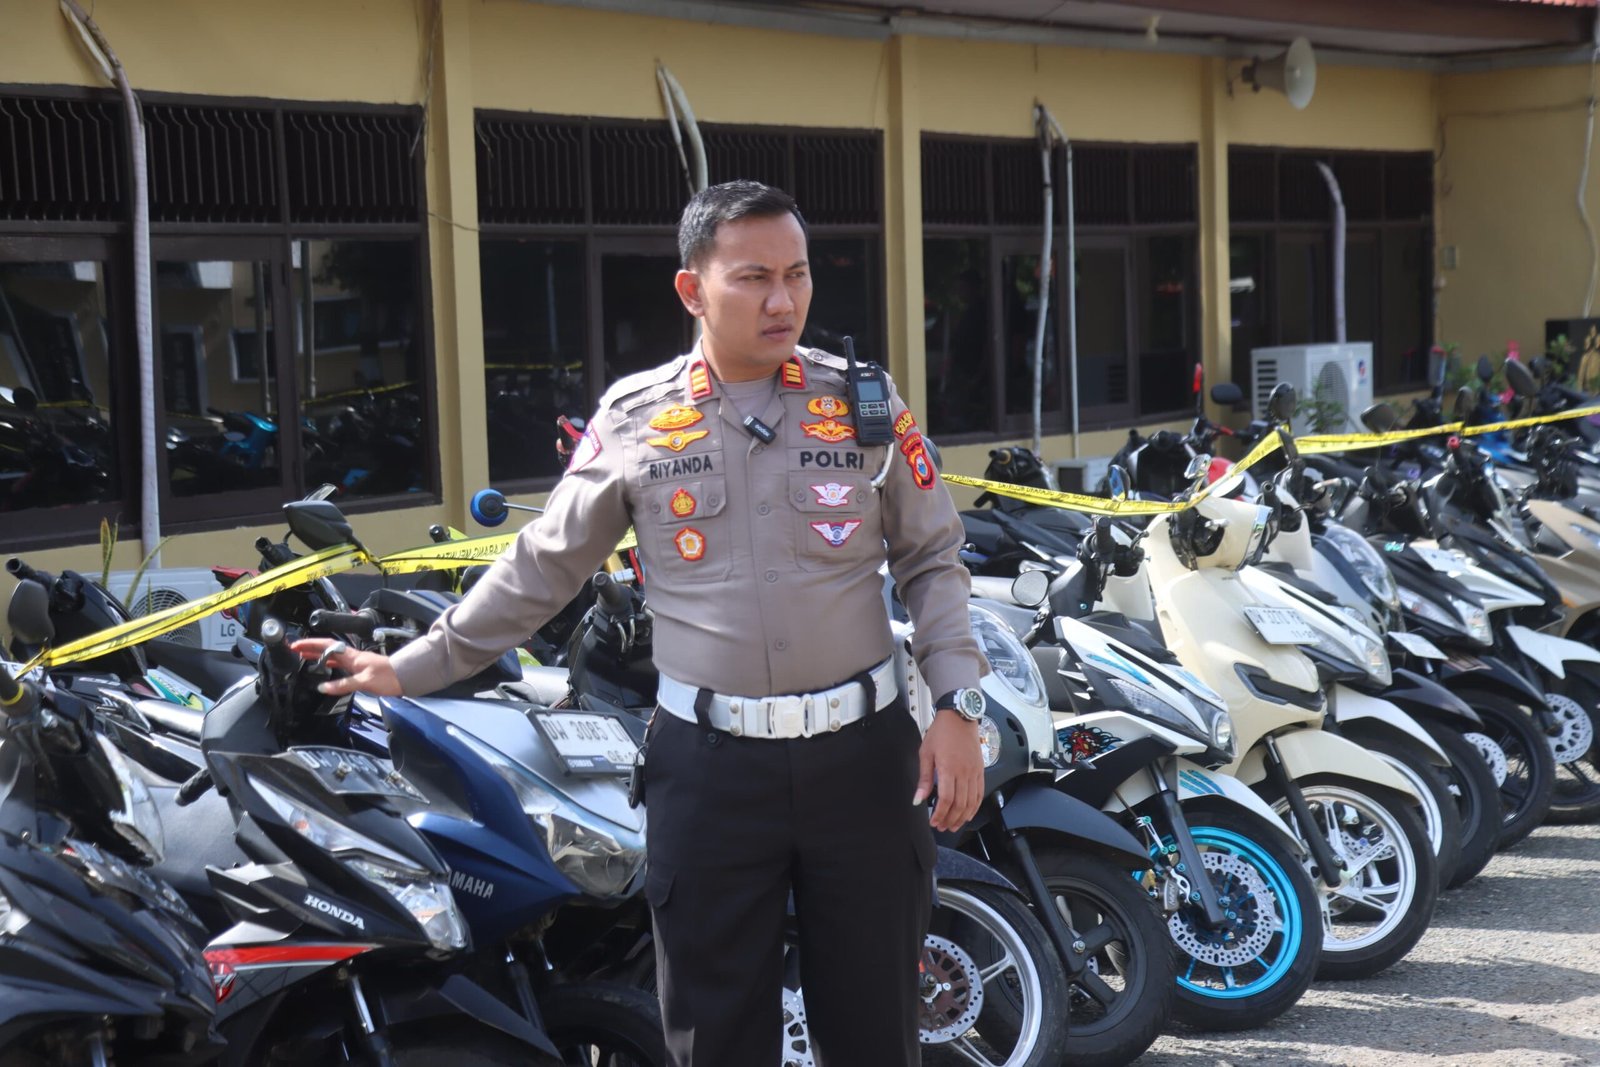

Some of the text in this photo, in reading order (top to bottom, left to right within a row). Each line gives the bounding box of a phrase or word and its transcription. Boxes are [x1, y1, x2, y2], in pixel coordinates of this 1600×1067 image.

[649, 454, 713, 480] RIYANDA
[800, 450, 864, 470] POLRI
[221, 623, 236, 637] LG
[540, 719, 569, 741] DW
[569, 720, 609, 741] 3085
[449, 870, 494, 899] MAHA
[303, 893, 366, 930] HONDA
